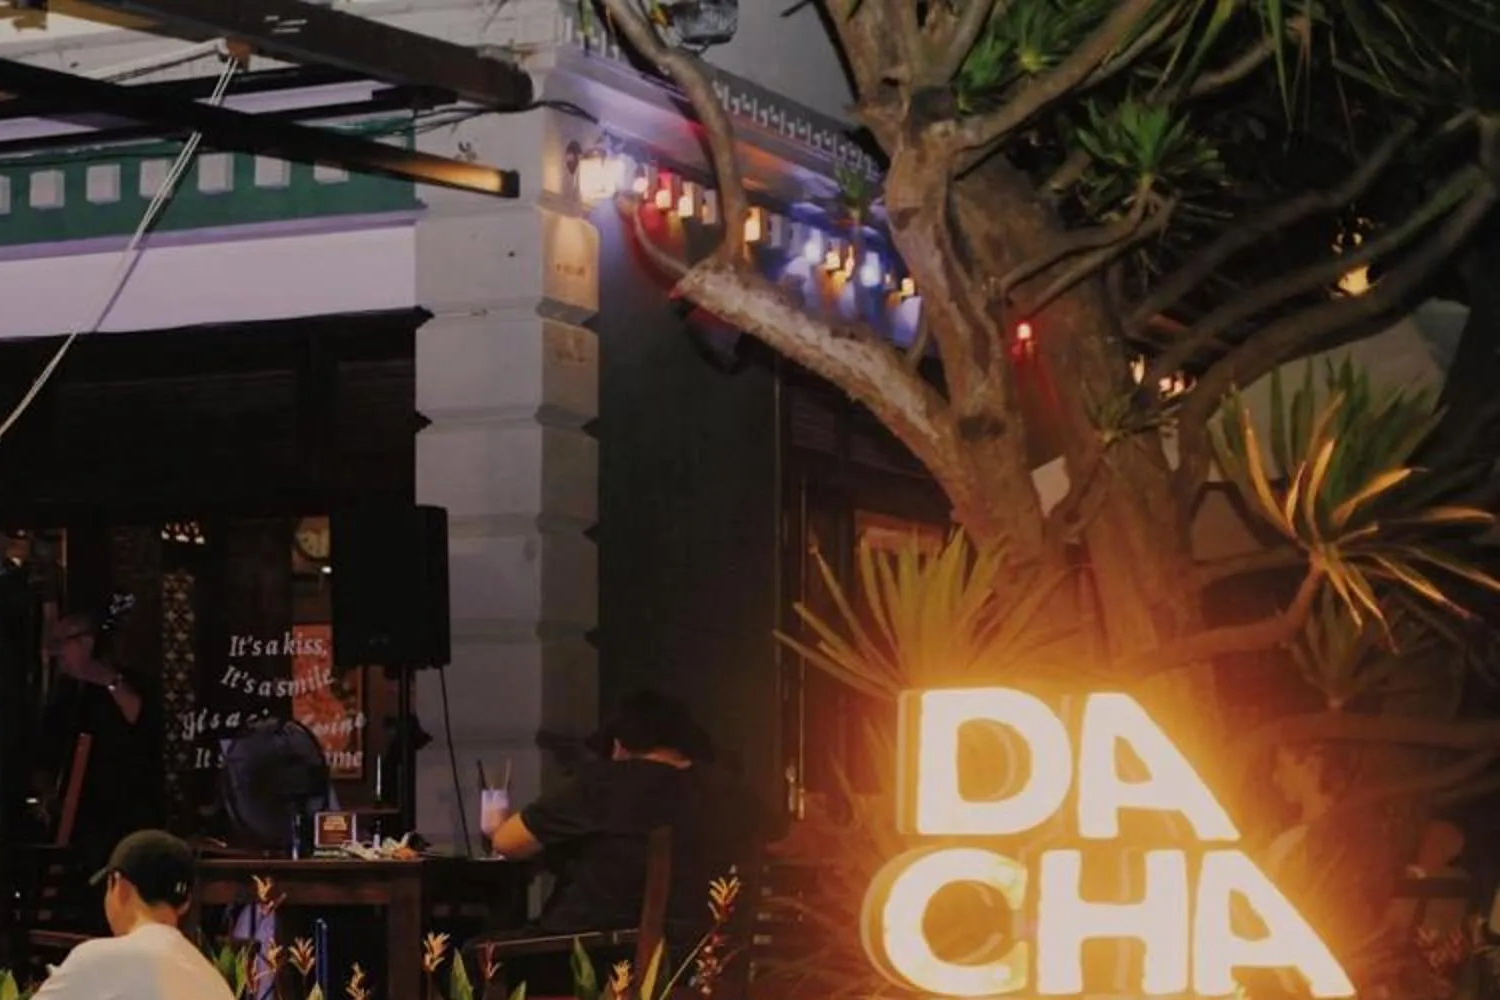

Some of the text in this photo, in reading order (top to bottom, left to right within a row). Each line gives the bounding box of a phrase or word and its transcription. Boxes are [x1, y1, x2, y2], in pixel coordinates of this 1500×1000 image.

[220, 664, 257, 695] It's
[258, 680, 272, 697] a
[228, 635, 263, 657] It's
[265, 639, 280, 656] a
[912, 686, 1241, 841] DA
[878, 848, 1357, 998] CHA
